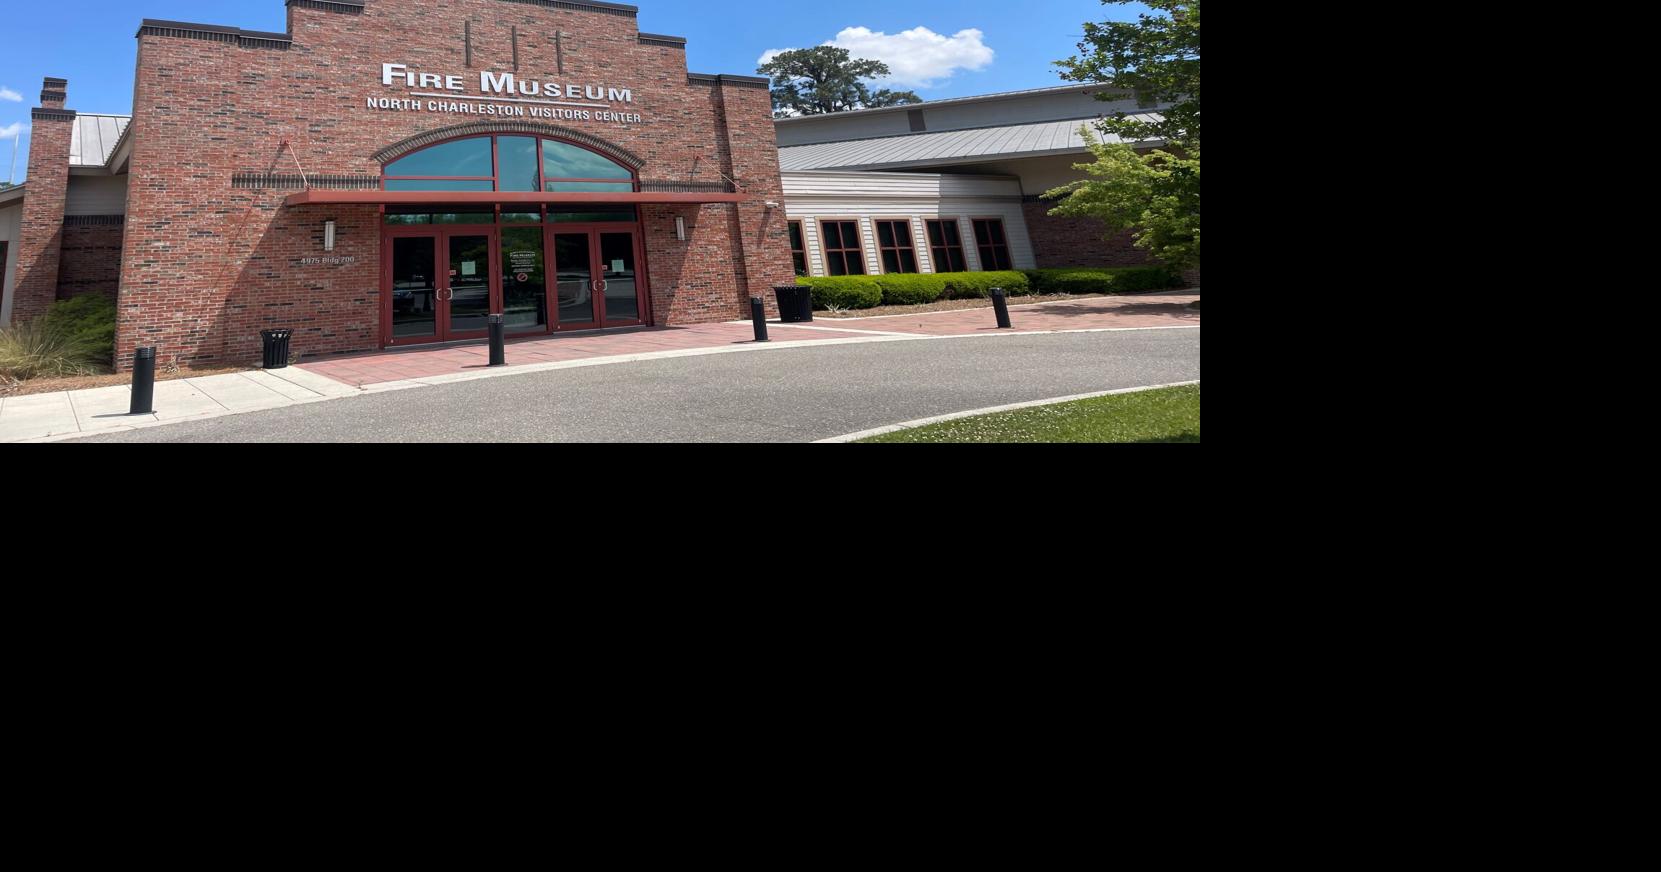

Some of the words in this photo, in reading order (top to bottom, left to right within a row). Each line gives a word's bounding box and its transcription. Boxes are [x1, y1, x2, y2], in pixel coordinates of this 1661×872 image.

[367, 97, 421, 111] NORTH
[428, 100, 523, 116] CHARLESTON
[530, 107, 590, 120] VISITORS
[595, 112, 641, 124] CENTER
[300, 257, 320, 265] 4975
[322, 256, 339, 265] Bldg
